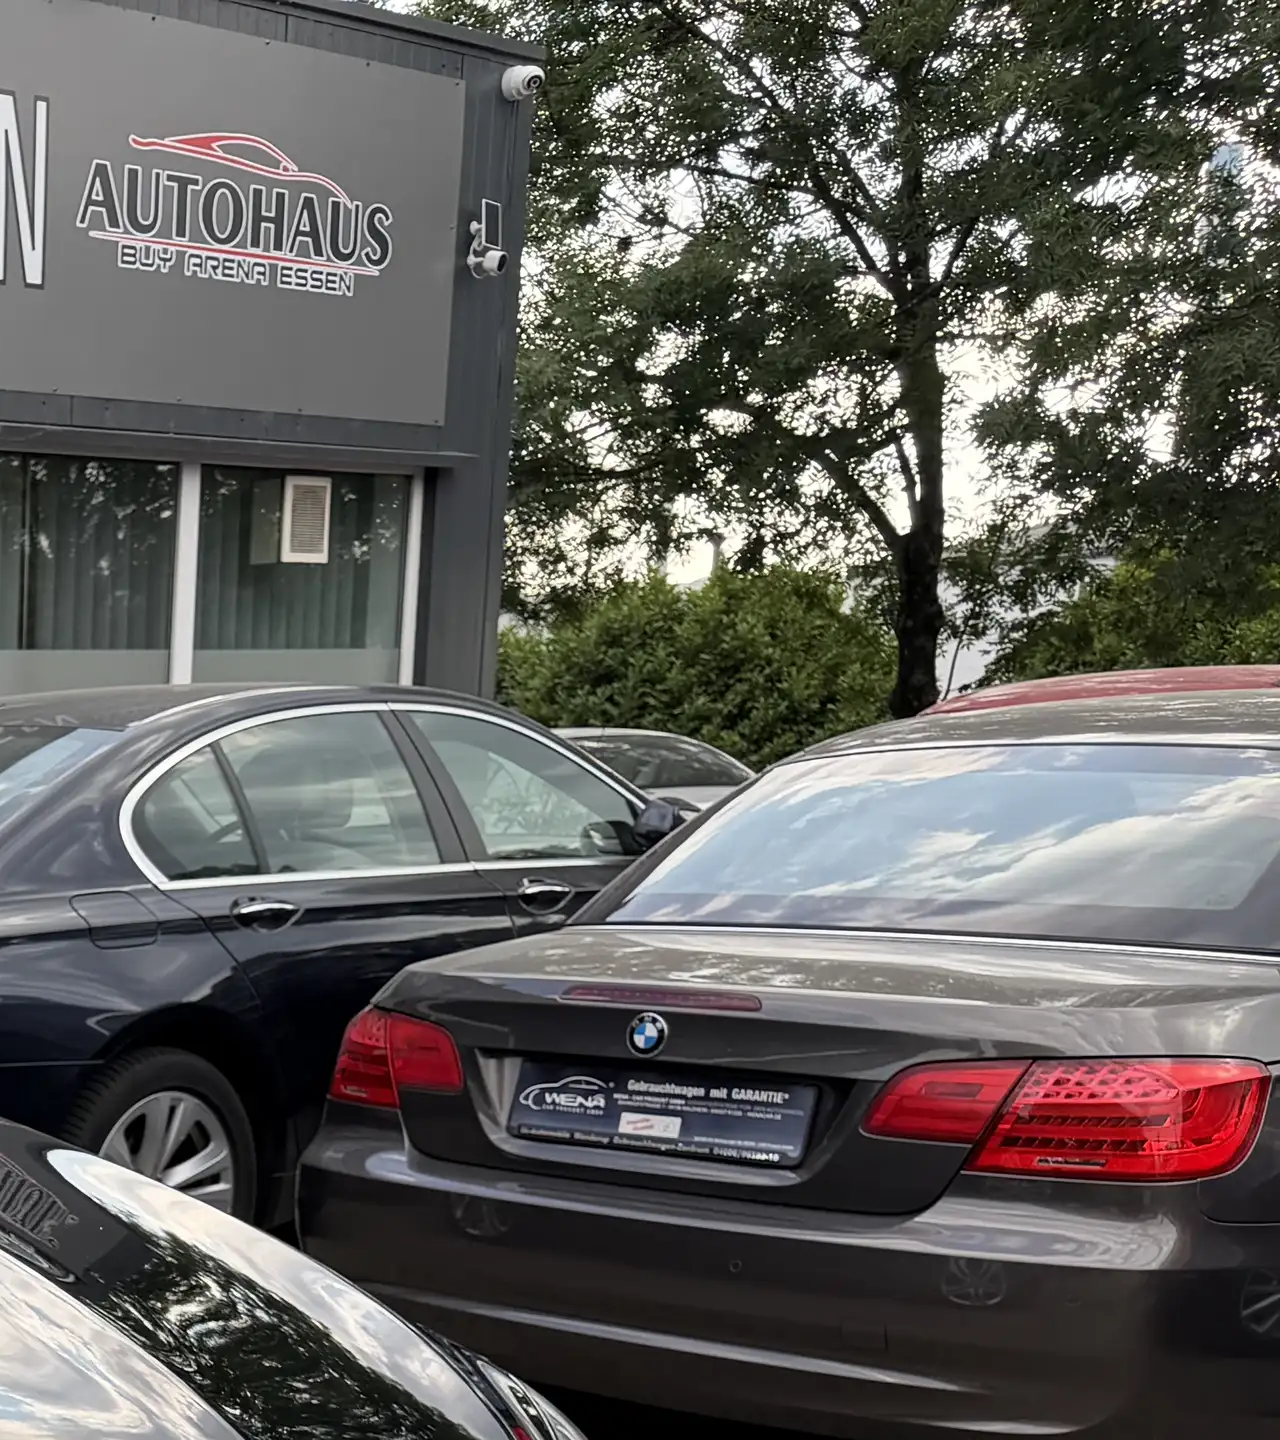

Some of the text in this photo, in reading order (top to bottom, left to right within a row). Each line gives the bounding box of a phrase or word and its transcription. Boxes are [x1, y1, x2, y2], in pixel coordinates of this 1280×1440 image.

[76, 159, 393, 268] AUTOHAUS
[117, 240, 355, 297] BUY ARENA ESSEN
[544, 1092, 606, 1109] WENA
[627, 1079, 706, 1098] Gebrauchtwagen
[709, 1087, 728, 1100] mit
